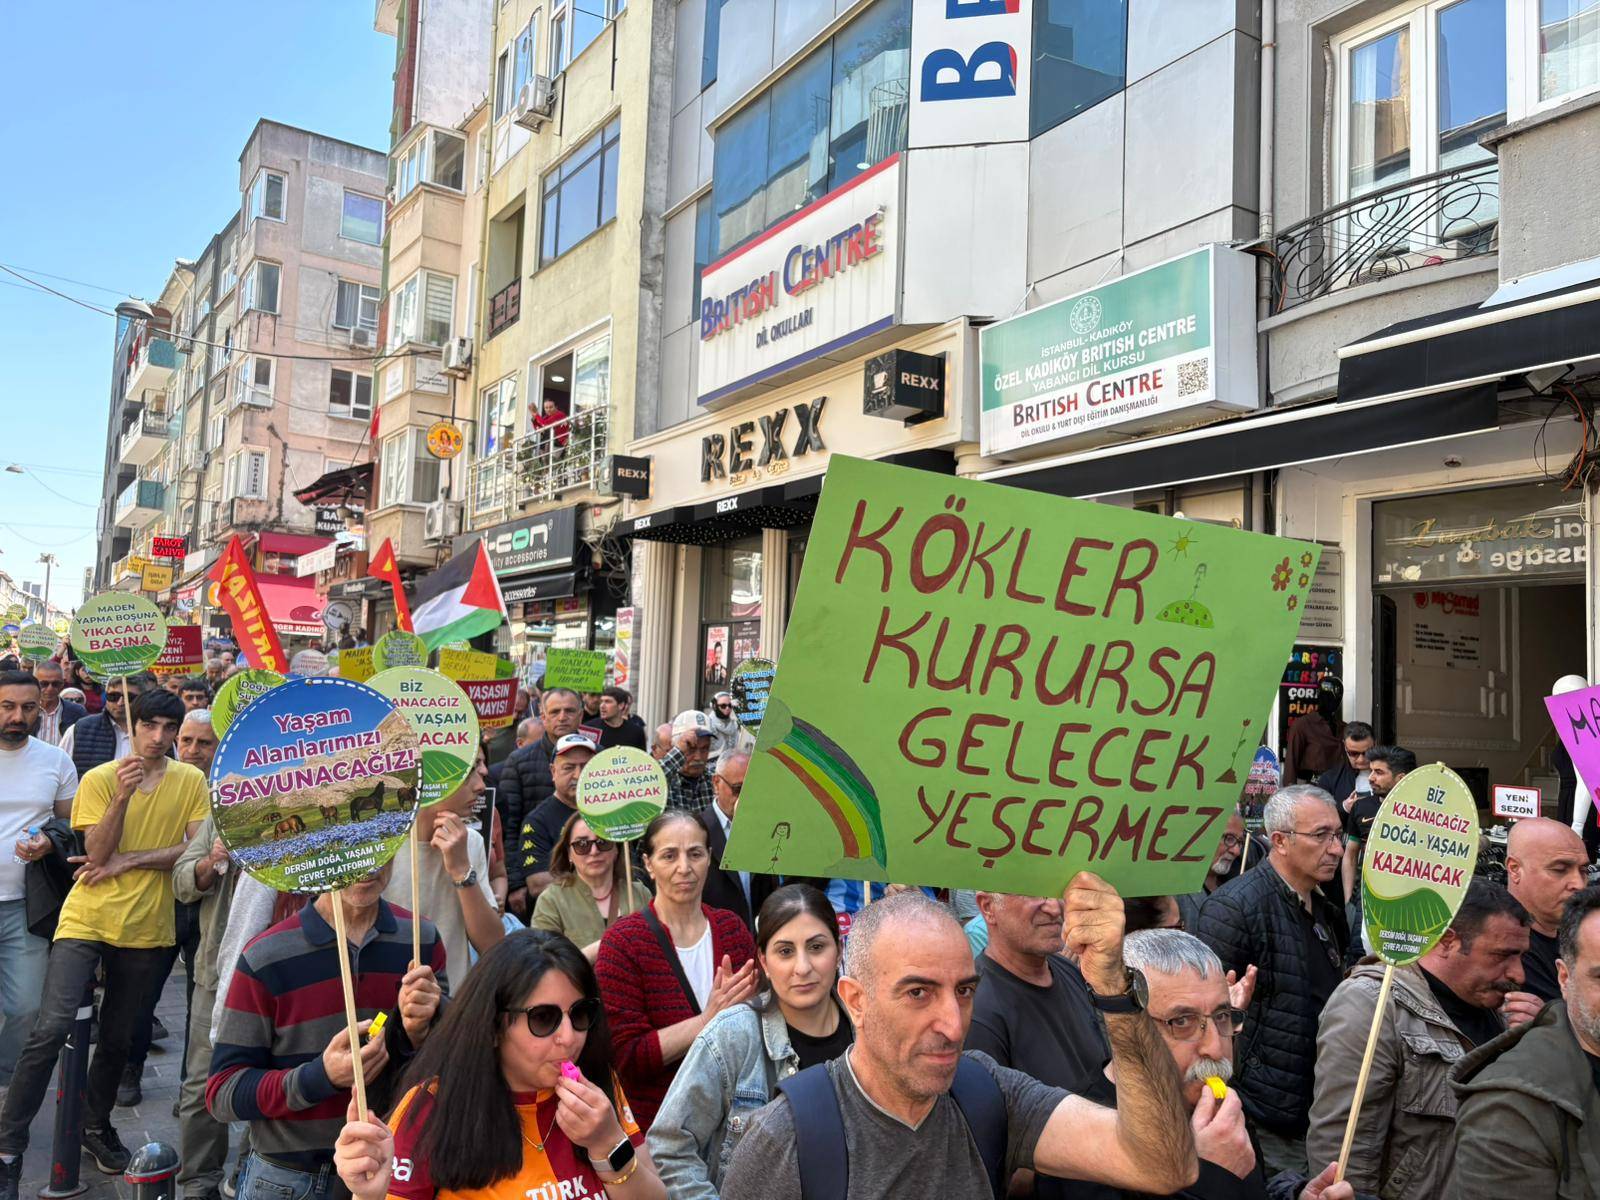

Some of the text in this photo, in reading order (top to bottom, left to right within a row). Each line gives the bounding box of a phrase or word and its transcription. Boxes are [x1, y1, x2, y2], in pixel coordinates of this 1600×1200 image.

[700, 205, 887, 342] BRITISH CENTRE
[756, 307, 814, 349] DİL OKULLARI
[994, 314, 1197, 392] ÖZEL KADIKÖY BRITISH CENTRE
[901, 371, 939, 391] REXX
[1031, 351, 1146, 393] YABANCI DİL KURSU
[1013, 368, 1163, 427] BRITISH CENTRE
[1057, 417, 1072, 430] YURT
[1086, 407, 1109, 423] EĞİTİM
[1110, 396, 1159, 418] DANIŞMANLIĞI
[701, 396, 830, 483] REXX
[617, 467, 648, 480] REXX
[717, 497, 738, 513] REXX
[634, 516, 651, 530] REXX
[505, 547, 548, 567] accessories
[834, 494, 1160, 625] KÖKLER
[504, 585, 537, 602] accessories
[76, 611, 158, 625] YAPMA BOŞUNA
[97, 603, 136, 614] MADEN
[82, 621, 157, 638] YIKACAĞIZ
[89, 635, 152, 652] BAŞINA
[862, 606, 1216, 719] KURURSA
[400, 679, 423, 693] BİZ
[392, 695, 459, 708] ANACAĞIZ
[273, 708, 351, 735] Yaşam
[415, 712, 467, 728] YAŞAM
[243, 730, 381, 769] Alanlarımızı
[418, 731, 469, 746] ACAK
[898, 706, 1211, 791] GELECEK
[588, 763, 653, 778] KAZANACAĞIZ
[611, 755, 628, 766] BİZ
[219, 749, 416, 805] SAVUNACAĞIZ!
[584, 777, 614, 791] DOĞA
[623, 773, 659, 788] YAŞAM
[583, 785, 661, 805] KAZANACAK
[1427, 785, 1445, 806] BİZ
[1392, 802, 1471, 834] KAZANACAĞIZ
[1501, 803, 1534, 816] SEZON
[912, 784, 1225, 869] YEŞERMEZ
[1380, 822, 1417, 847] DOĞA
[1427, 834, 1470, 859] YAŞAM
[284, 843, 385, 876] DERSİM DOĞA, YAŞAM VE
[298, 856, 376, 885] ÇEVRE PLATFORMU
[1372, 851, 1465, 888] KAZANACAK
[526, 1174, 588, 1200] TÜRK
